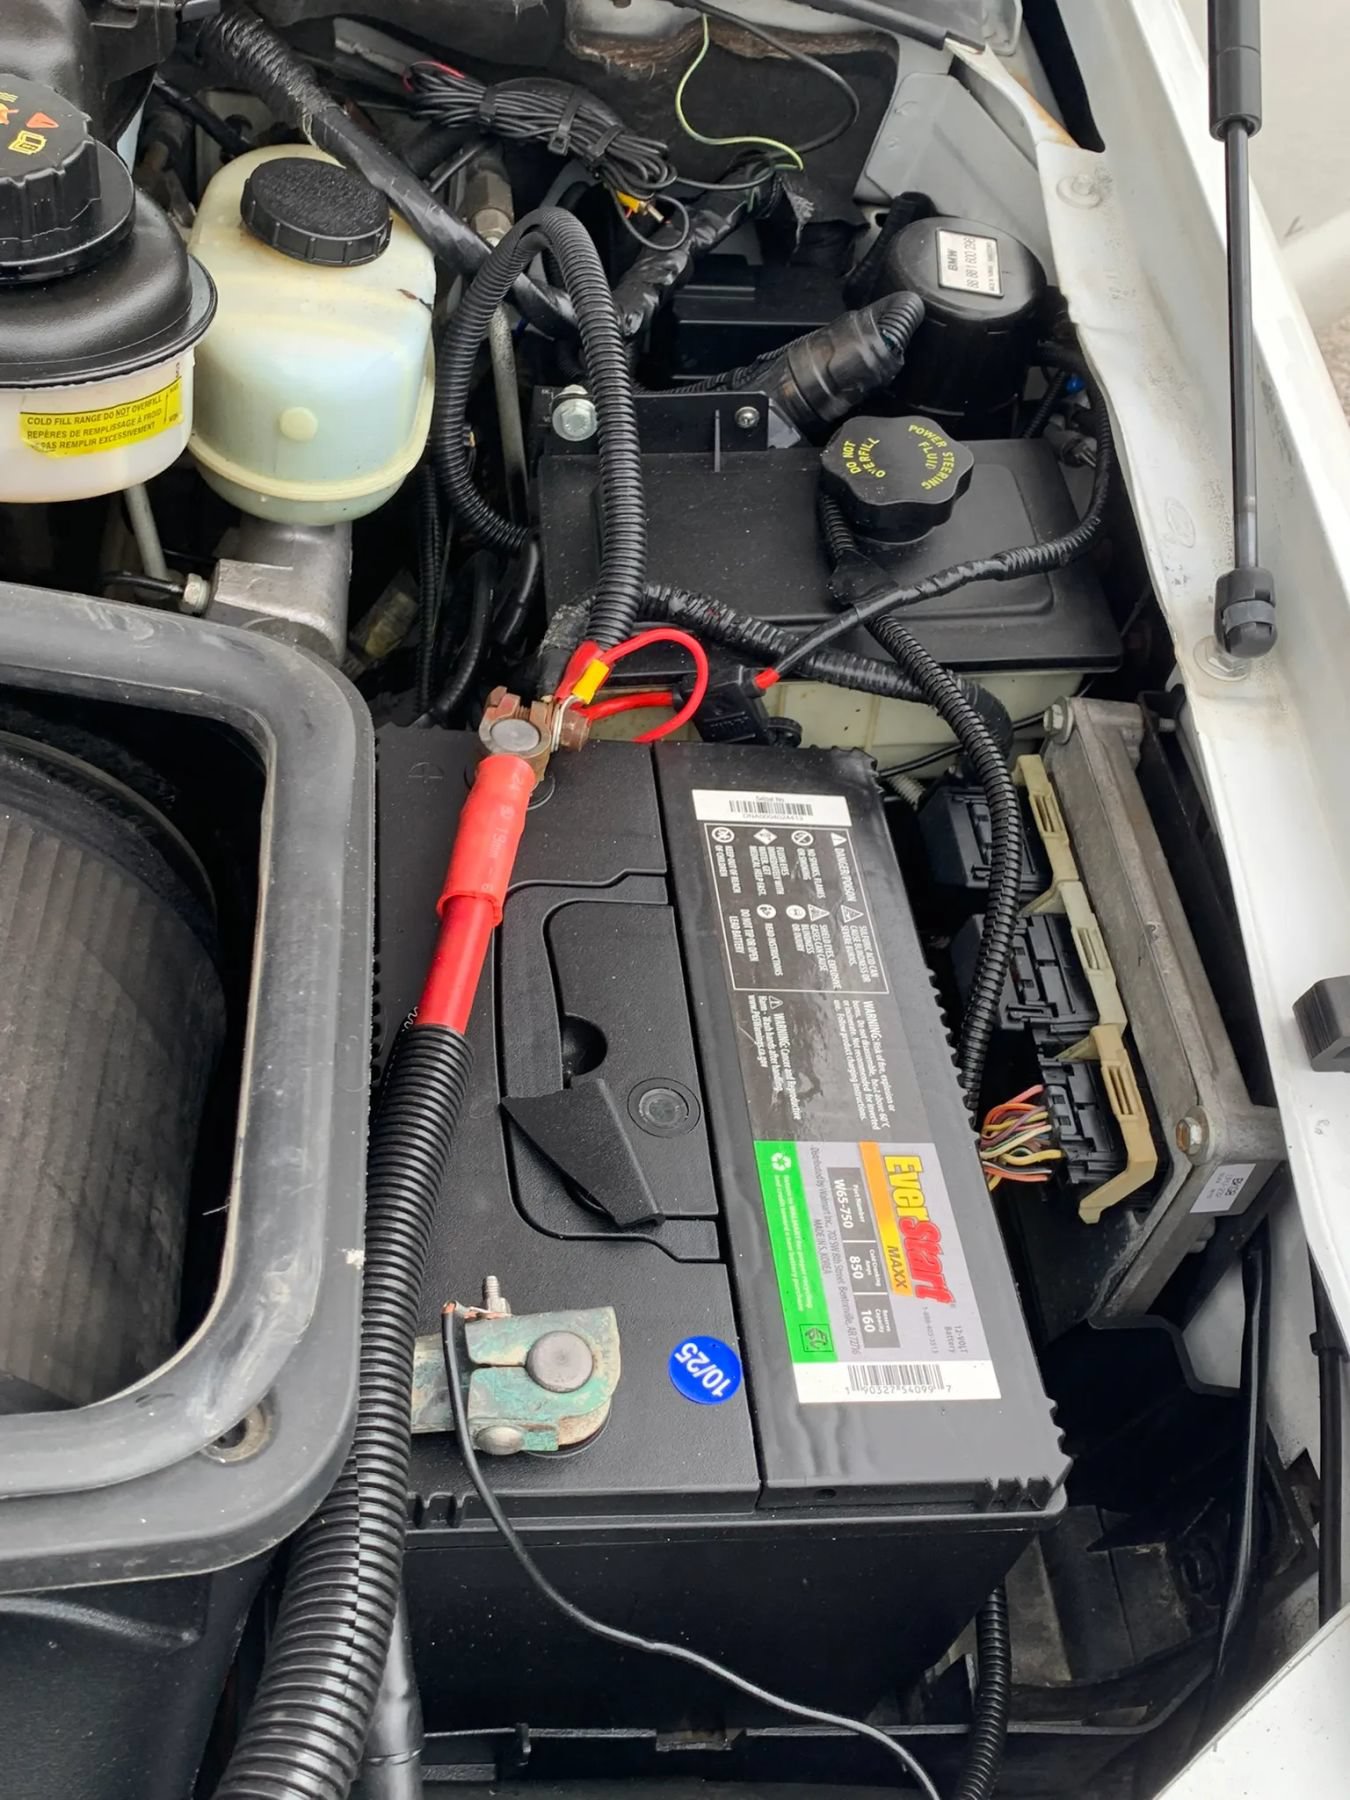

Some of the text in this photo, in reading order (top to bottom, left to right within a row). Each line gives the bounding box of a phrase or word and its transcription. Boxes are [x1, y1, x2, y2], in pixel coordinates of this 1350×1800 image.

[947, 248, 958, 271] BMW
[27, 396, 162, 425] COLD FILL RANGE DO NOT OVERFILL
[27, 429, 67, 439] REPÈRES
[83, 418, 136, 436] REMPLISSAGE
[59, 438, 97, 449] REMPLIR
[99, 421, 155, 444] EXCESSIVEMENT
[842, 440, 862, 474] DO NOT
[858, 438, 886, 478] OVERFILL
[908, 424, 955, 490] POWER STEERING
[918, 441, 938, 470] FLUID
[716, 851, 727, 876] CHILDREN
[728, 915, 744, 953] LEAD BATTERY
[740, 908, 758, 961] DO NOT TIP OR OPEN
[800, 923, 814, 953] BLINDNESS
[810, 923, 828, 971] GASES CAN CAUSE
[764, 922, 783, 975] READ INSTRUCTIONS
[819, 924, 831, 943] SHIELD
[827, 959, 841, 988] EXPLOSIVE
[849, 924, 871, 982] CAUSE BLINDNESS OR
[858, 925, 878, 977] SULFURIC ACID CAN
[856, 1019, 865, 1028] Do
[858, 1028, 868, 1038] not
[773, 1012, 802, 1119] WARNING: Cancer and Reproductive
[862, 1000, 881, 1040] WARNING:
[872, 1041, 882, 1054] Risk
[879, 1074, 893, 1103] explosion
[887, 1103, 895, 1111] or
[874, 1093, 884, 1112] above
[809, 1146, 824, 1179] Distributed
[815, 1179, 825, 1187] by
[818, 1187, 830, 1214] Walmart
[834, 1178, 853, 1228] W65-750
[852, 1184, 864, 1222] Part Number
[826, 1229, 837, 1240] 702
[883, 1156, 955, 1303] EverStart
[813, 1218, 824, 1236] MADE
[819, 1252, 832, 1274] KOREA
[828, 1240, 839, 1252] SW
[831, 1252, 841, 1264] 8th
[833, 1264, 845, 1284] Street
[849, 1255, 863, 1279] 850
[871, 1262, 881, 1286] Cranking
[887, 1245, 907, 1288] MAXX
[846, 1326, 857, 1336] AR
[860, 1310, 875, 1332] 160
[874, 1308, 884, 1333] Capacity
[882, 1309, 890, 1332] Reserve
[943, 1325, 955, 1352] Battery
[954, 1325, 968, 1353] 12-VOLT
[674, 1343, 731, 1397] 10/25
[863, 1385, 895, 1394] 90327
[902, 1385, 934, 1394] 54099
[947, 1385, 952, 1393] 7
